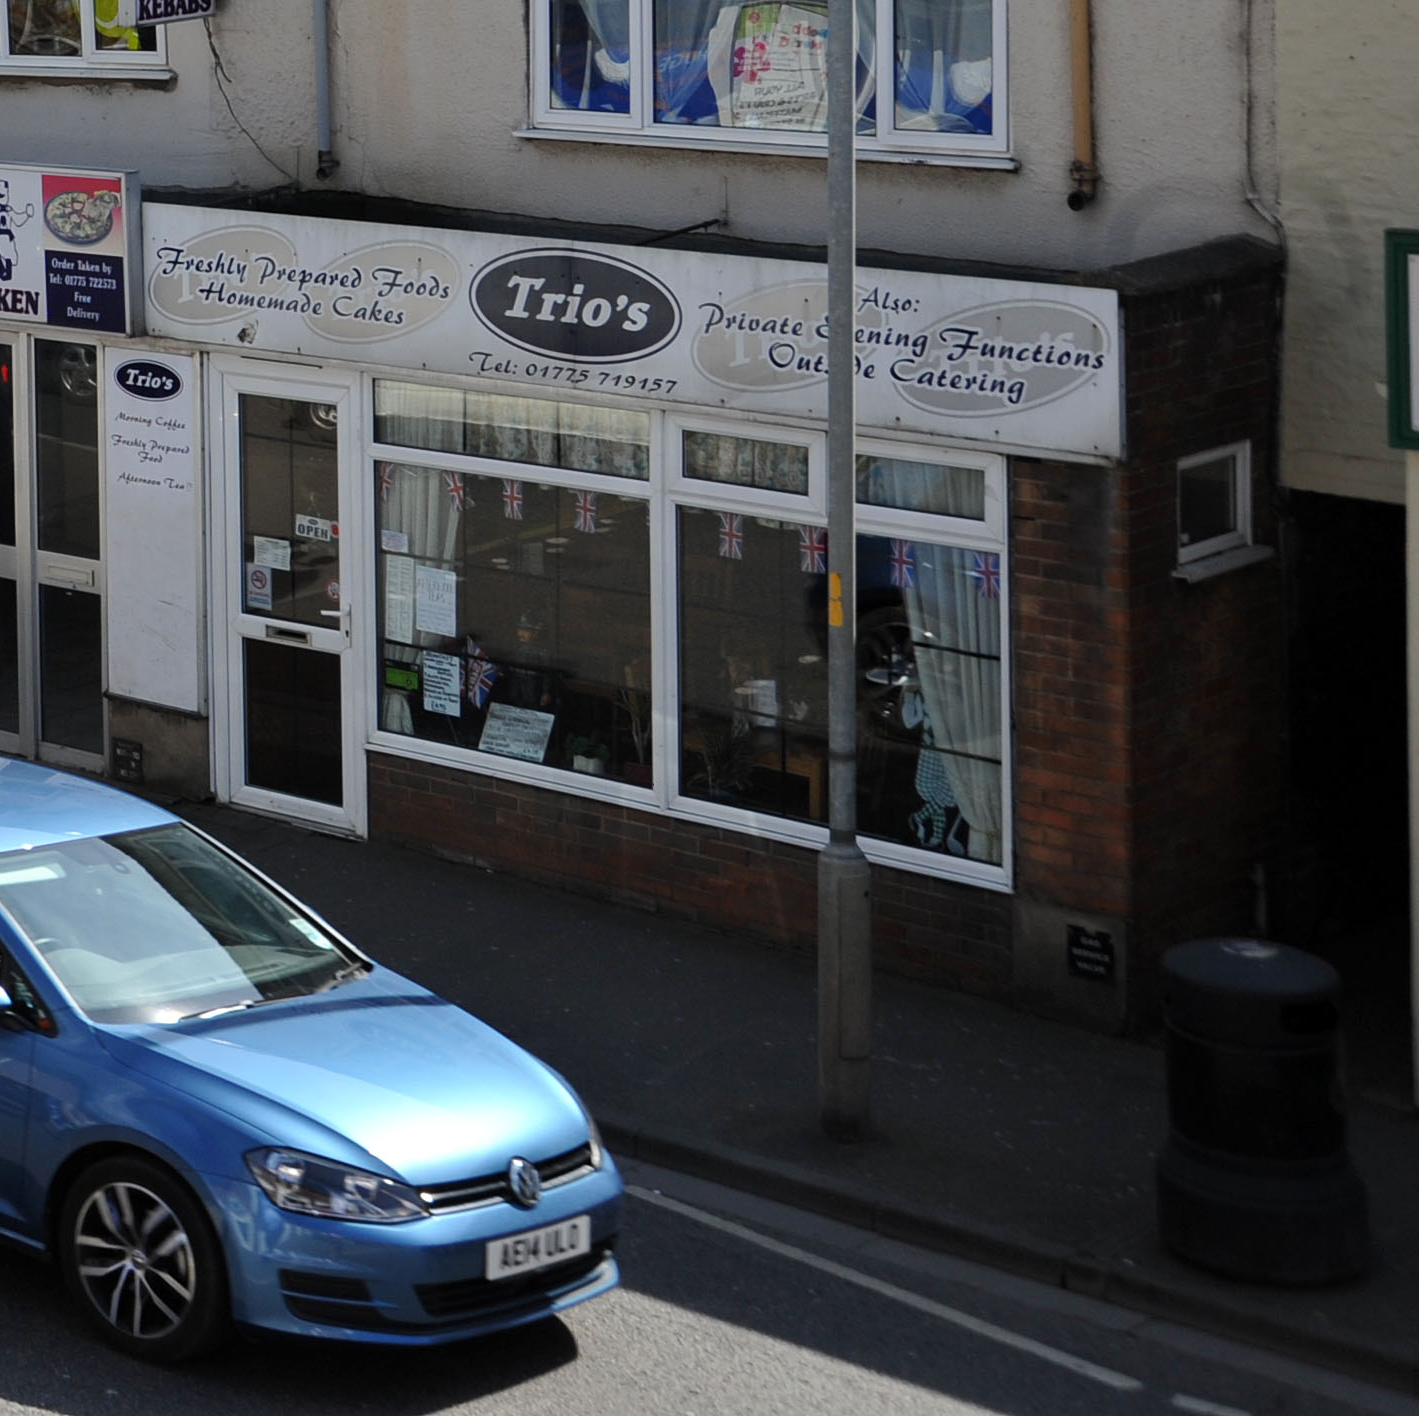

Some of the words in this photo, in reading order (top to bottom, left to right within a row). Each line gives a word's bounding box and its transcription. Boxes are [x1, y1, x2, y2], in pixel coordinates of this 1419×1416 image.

[51, 257, 75, 272] Order
[77, 259, 99, 273] Taken
[101, 263, 112, 275] by
[157, 245, 249, 282] Freshly
[255, 255, 365, 291] Prepared
[371, 267, 450, 301] Foods
[49, 273, 63, 286] Tel:
[64, 275, 86, 288] 01775
[88, 277, 117, 290] 722573
[74, 291, 92, 304] Free
[198, 281, 323, 317] Homemade
[332, 295, 404, 325] Cakes
[504, 275, 650, 333] Trio's
[857, 286, 920, 314] Also:
[67, 307, 100, 322] Delivery
[698, 301, 804, 338] Private
[940, 326, 1104, 370] Functions
[125, 368, 173, 390] Trio's
[469, 350, 518, 376] Tel:
[524, 362, 590, 386] 01775
[597, 370, 679, 395] 719157
[891, 359, 1026, 404] Catering
[115, 412, 152, 427] Morning
[155, 417, 185, 431] Coffee
[111, 434, 146, 450] Freshly
[149, 440, 190, 454] Prepared
[138, 451, 162, 463] Food
[116, 472, 161, 485] Afternoon
[297, 523, 328, 540] OPEN
